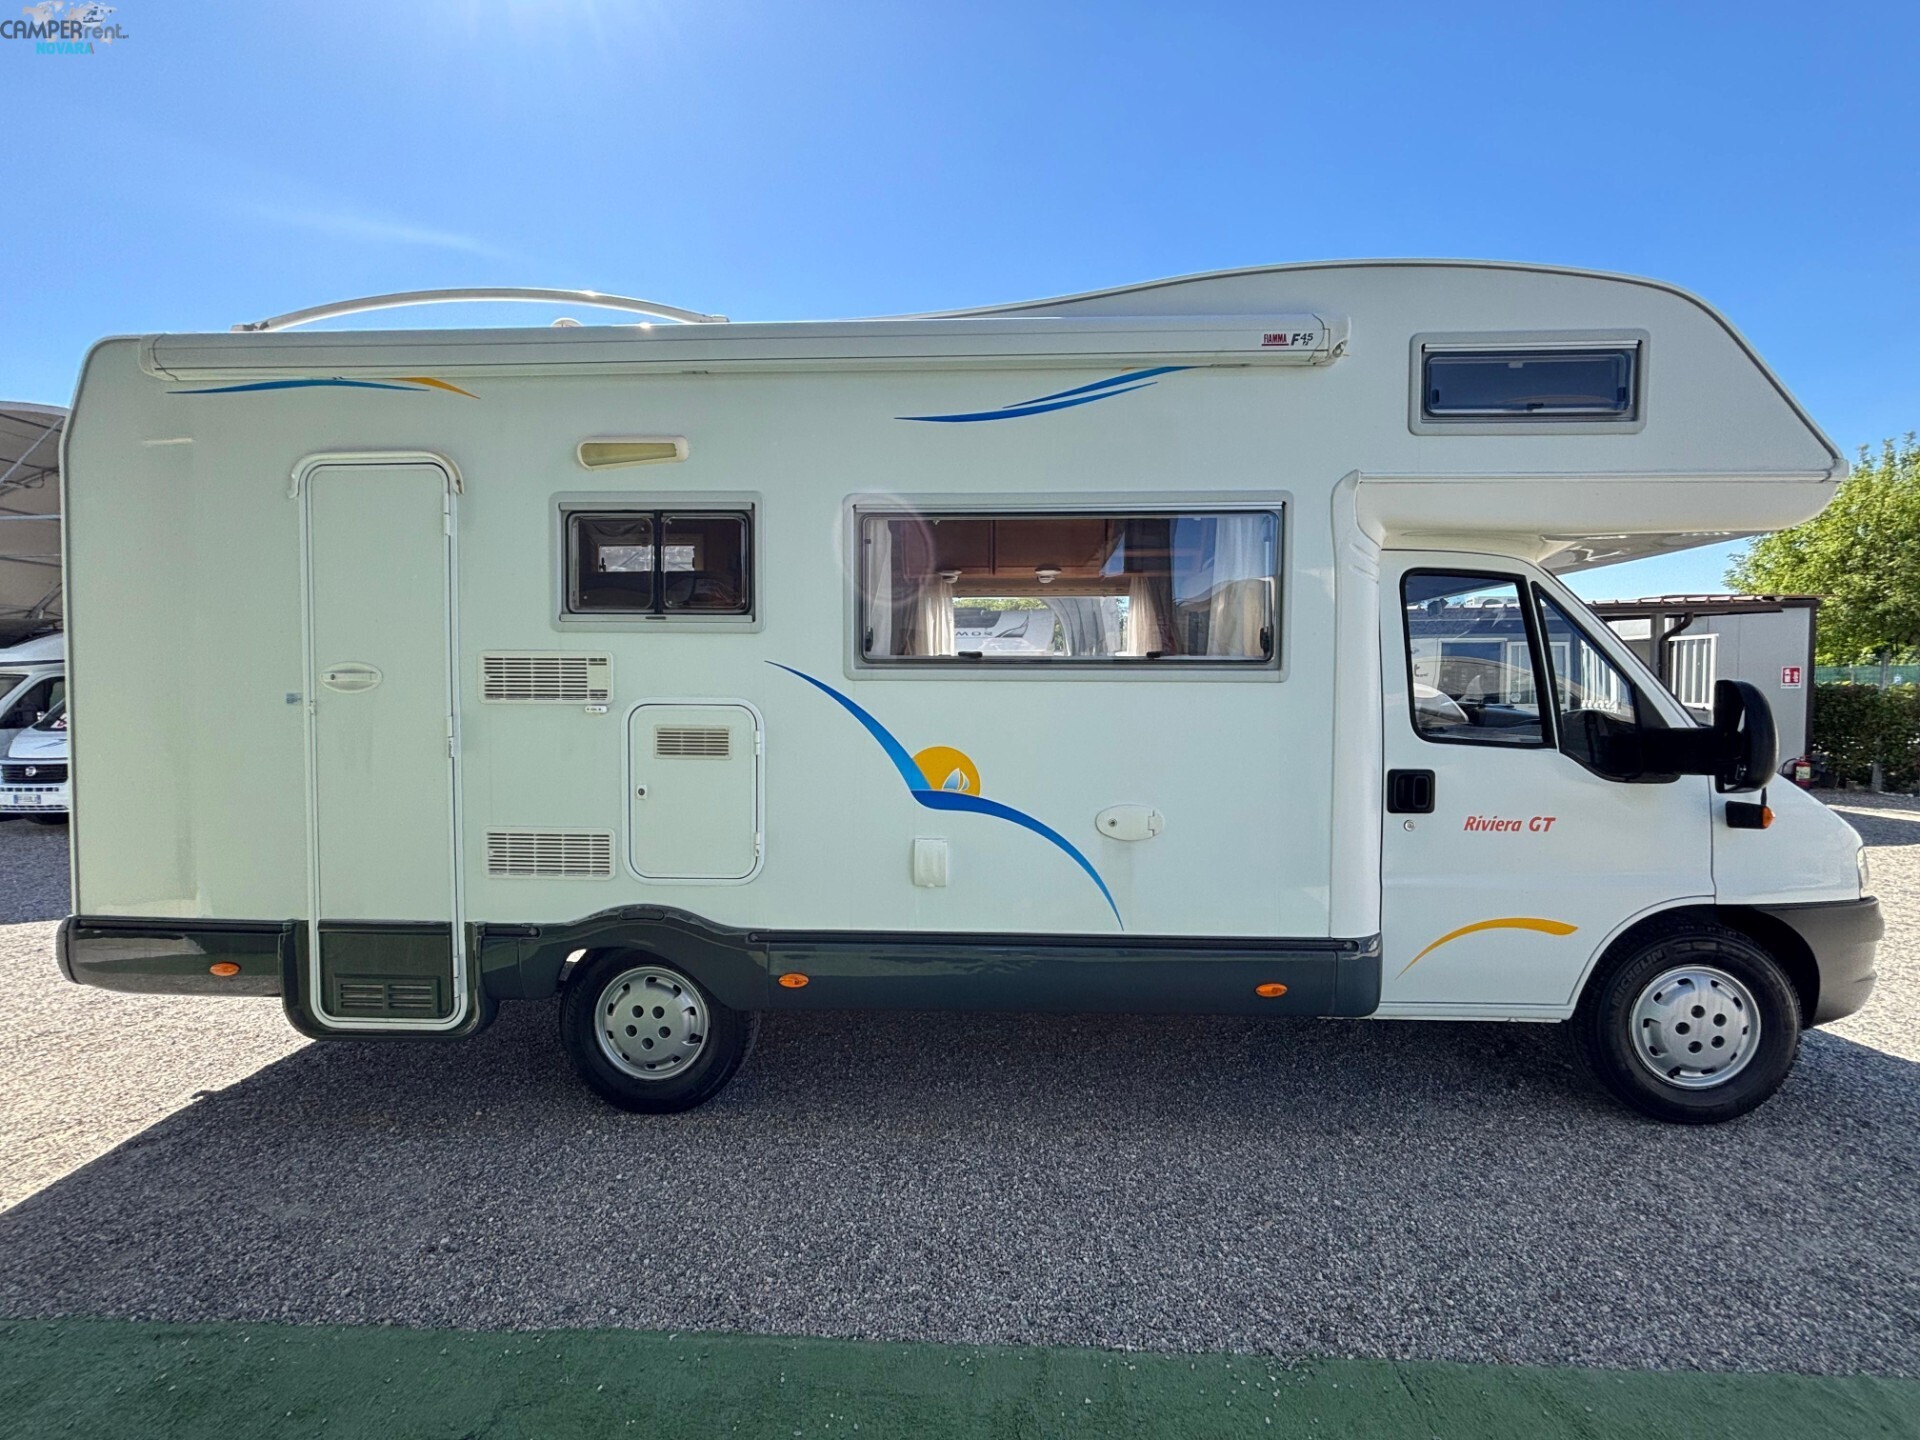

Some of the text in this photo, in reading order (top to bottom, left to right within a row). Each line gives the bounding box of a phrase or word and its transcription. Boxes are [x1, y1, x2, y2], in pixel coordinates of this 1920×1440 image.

[1263, 333, 1288, 344] FIAMMA
[1464, 816, 1556, 832] Riviera GT
[1611, 949, 1665, 1007] MICHELIN
